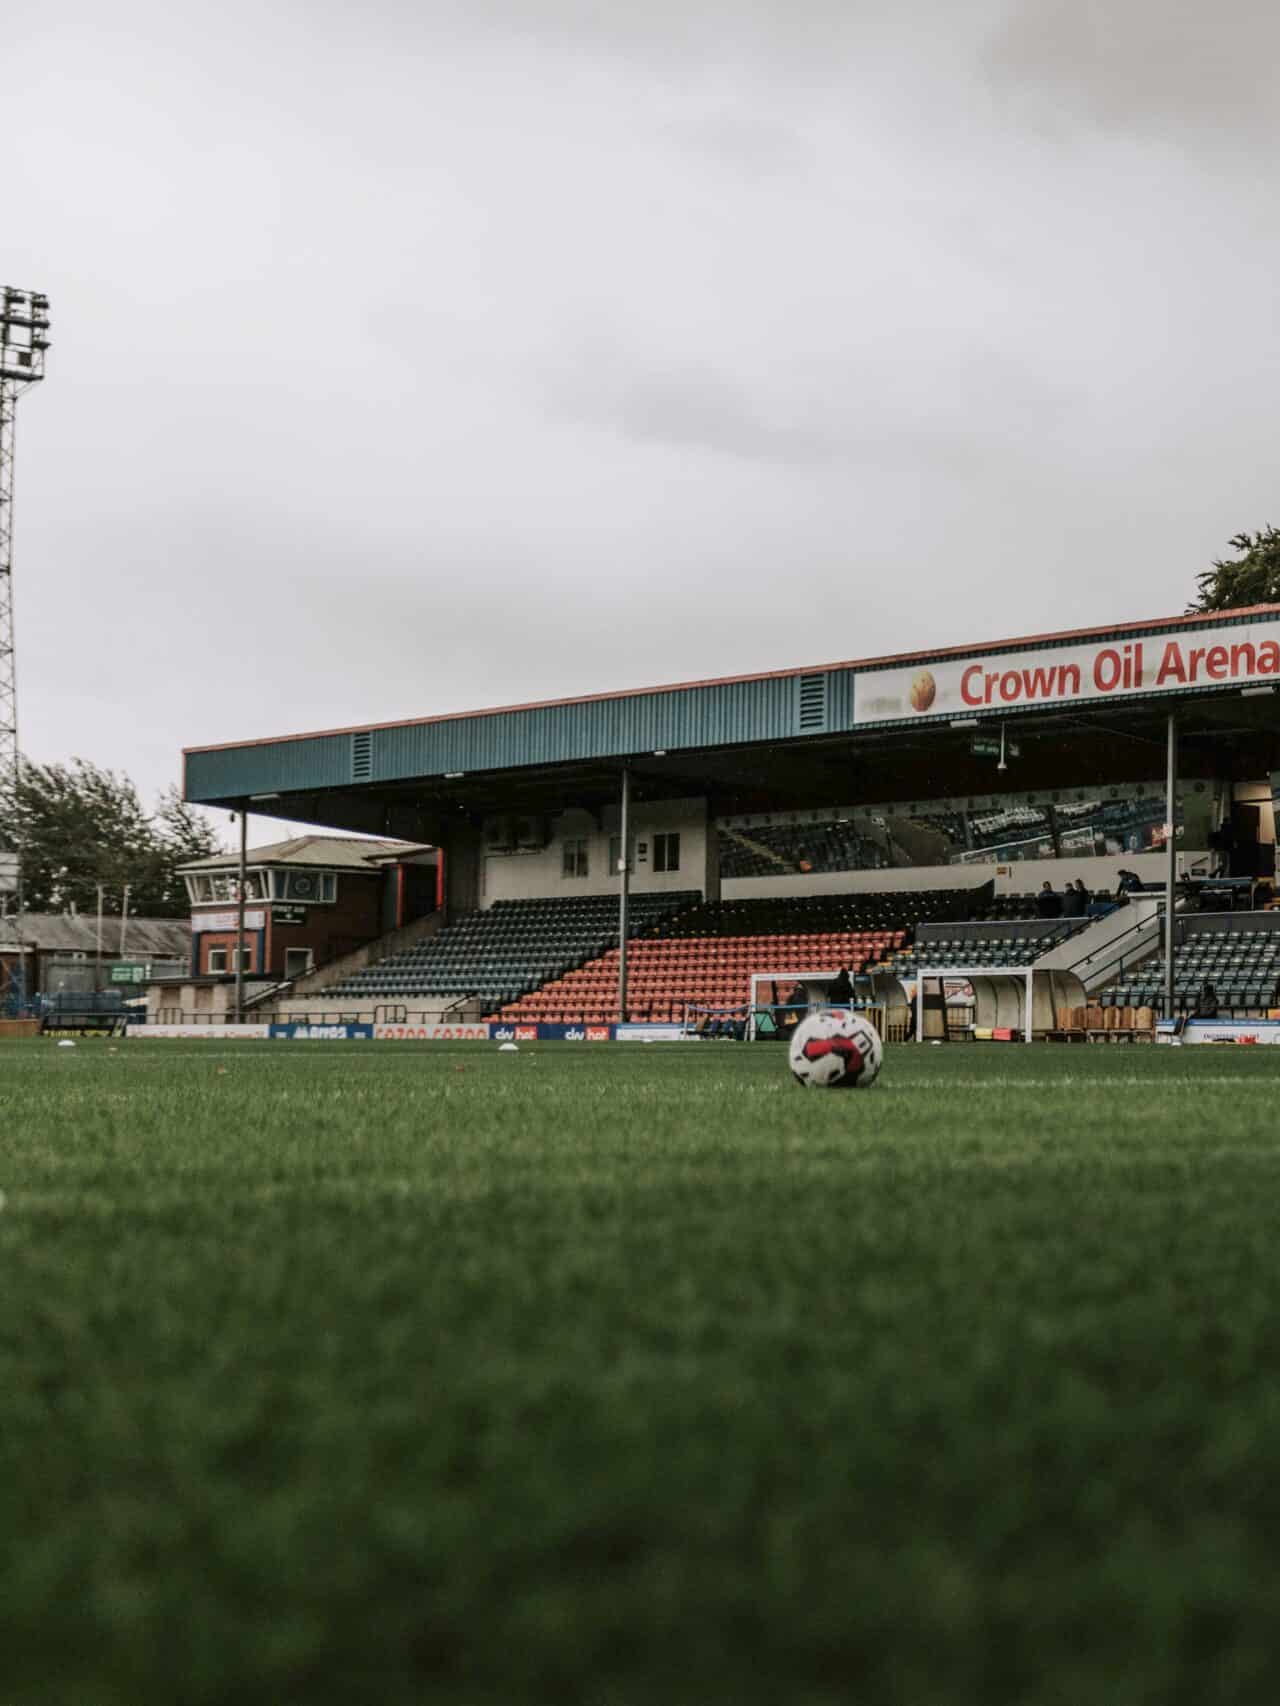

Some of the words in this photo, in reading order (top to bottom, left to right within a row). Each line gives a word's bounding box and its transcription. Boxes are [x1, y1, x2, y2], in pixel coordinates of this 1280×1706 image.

[960, 664, 1081, 706] Crown
[1093, 643, 1143, 692] Oil
[1156, 640, 1280, 686] Arena
